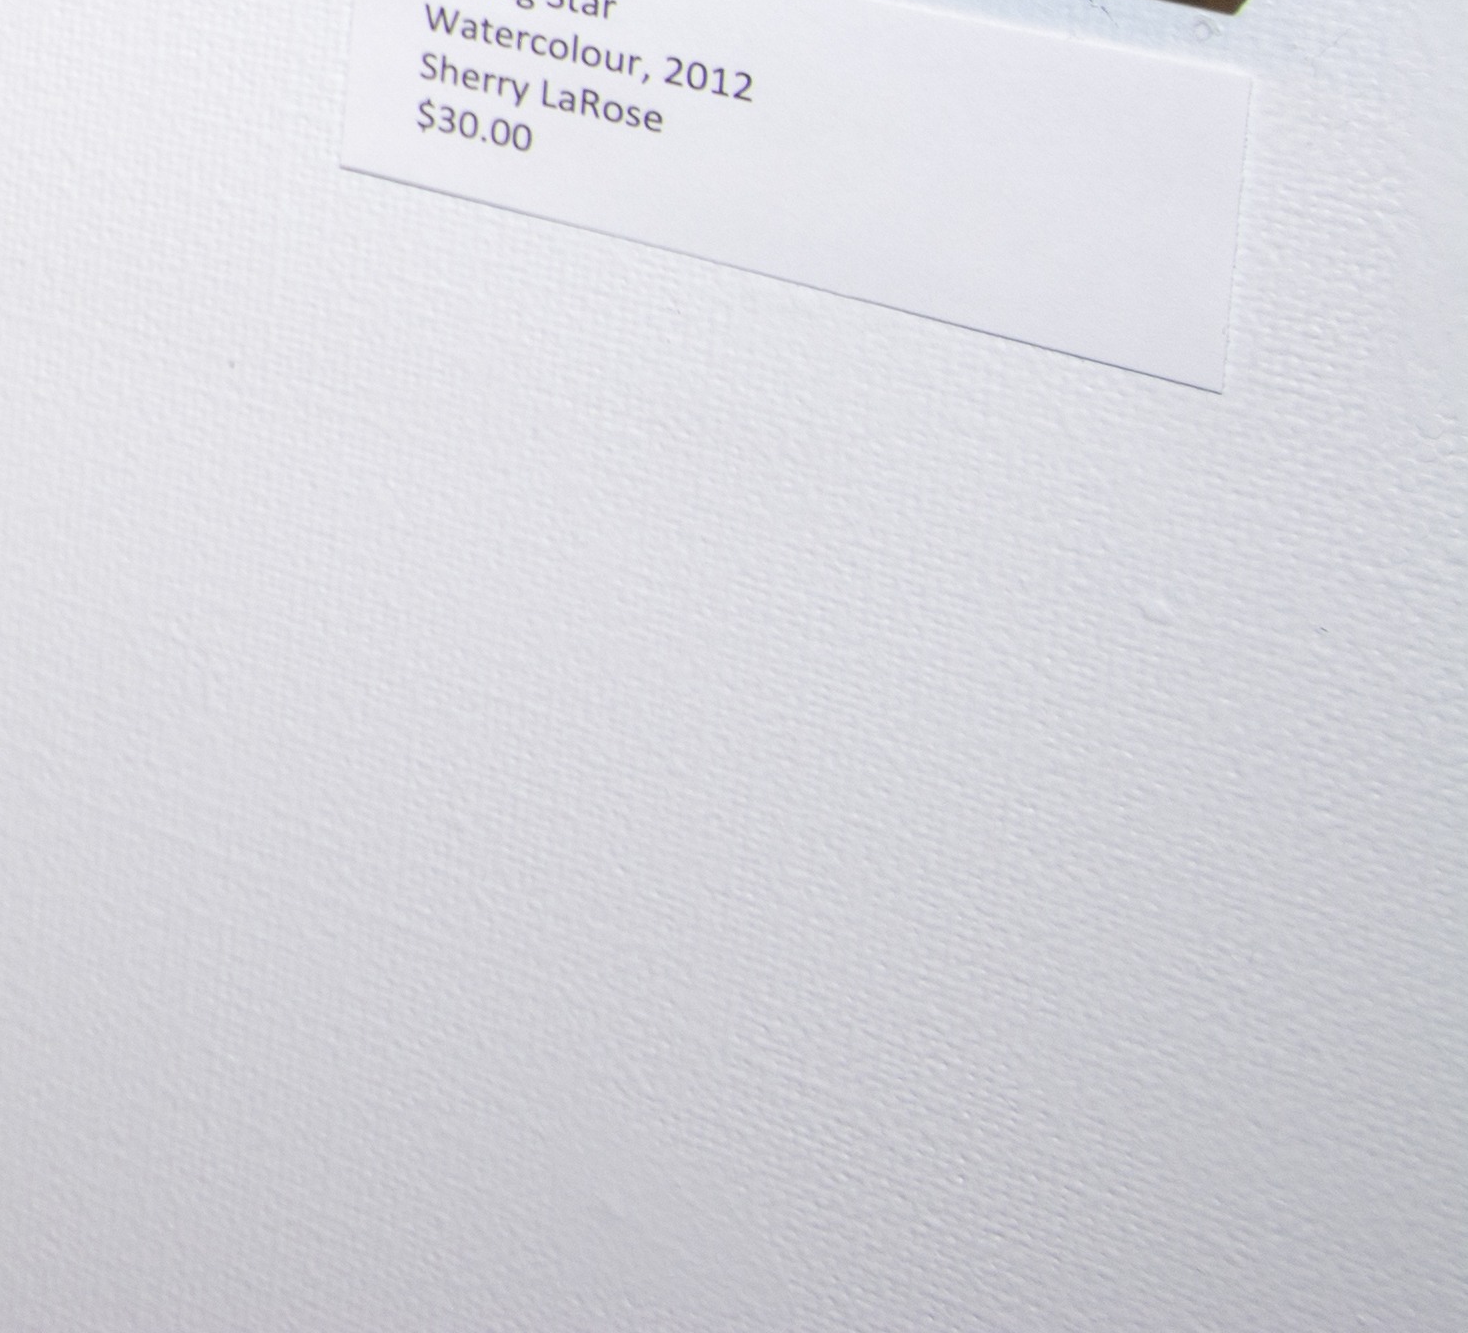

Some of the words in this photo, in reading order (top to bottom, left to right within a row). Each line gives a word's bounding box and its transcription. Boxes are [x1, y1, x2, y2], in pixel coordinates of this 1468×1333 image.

[419, 52, 529, 108] Sherry
[542, 79, 664, 133] LaRose
[424, 3, 650, 85] Watercolour,
[664, 56, 754, 102] 2012
[416, 98, 533, 152] $30.00
